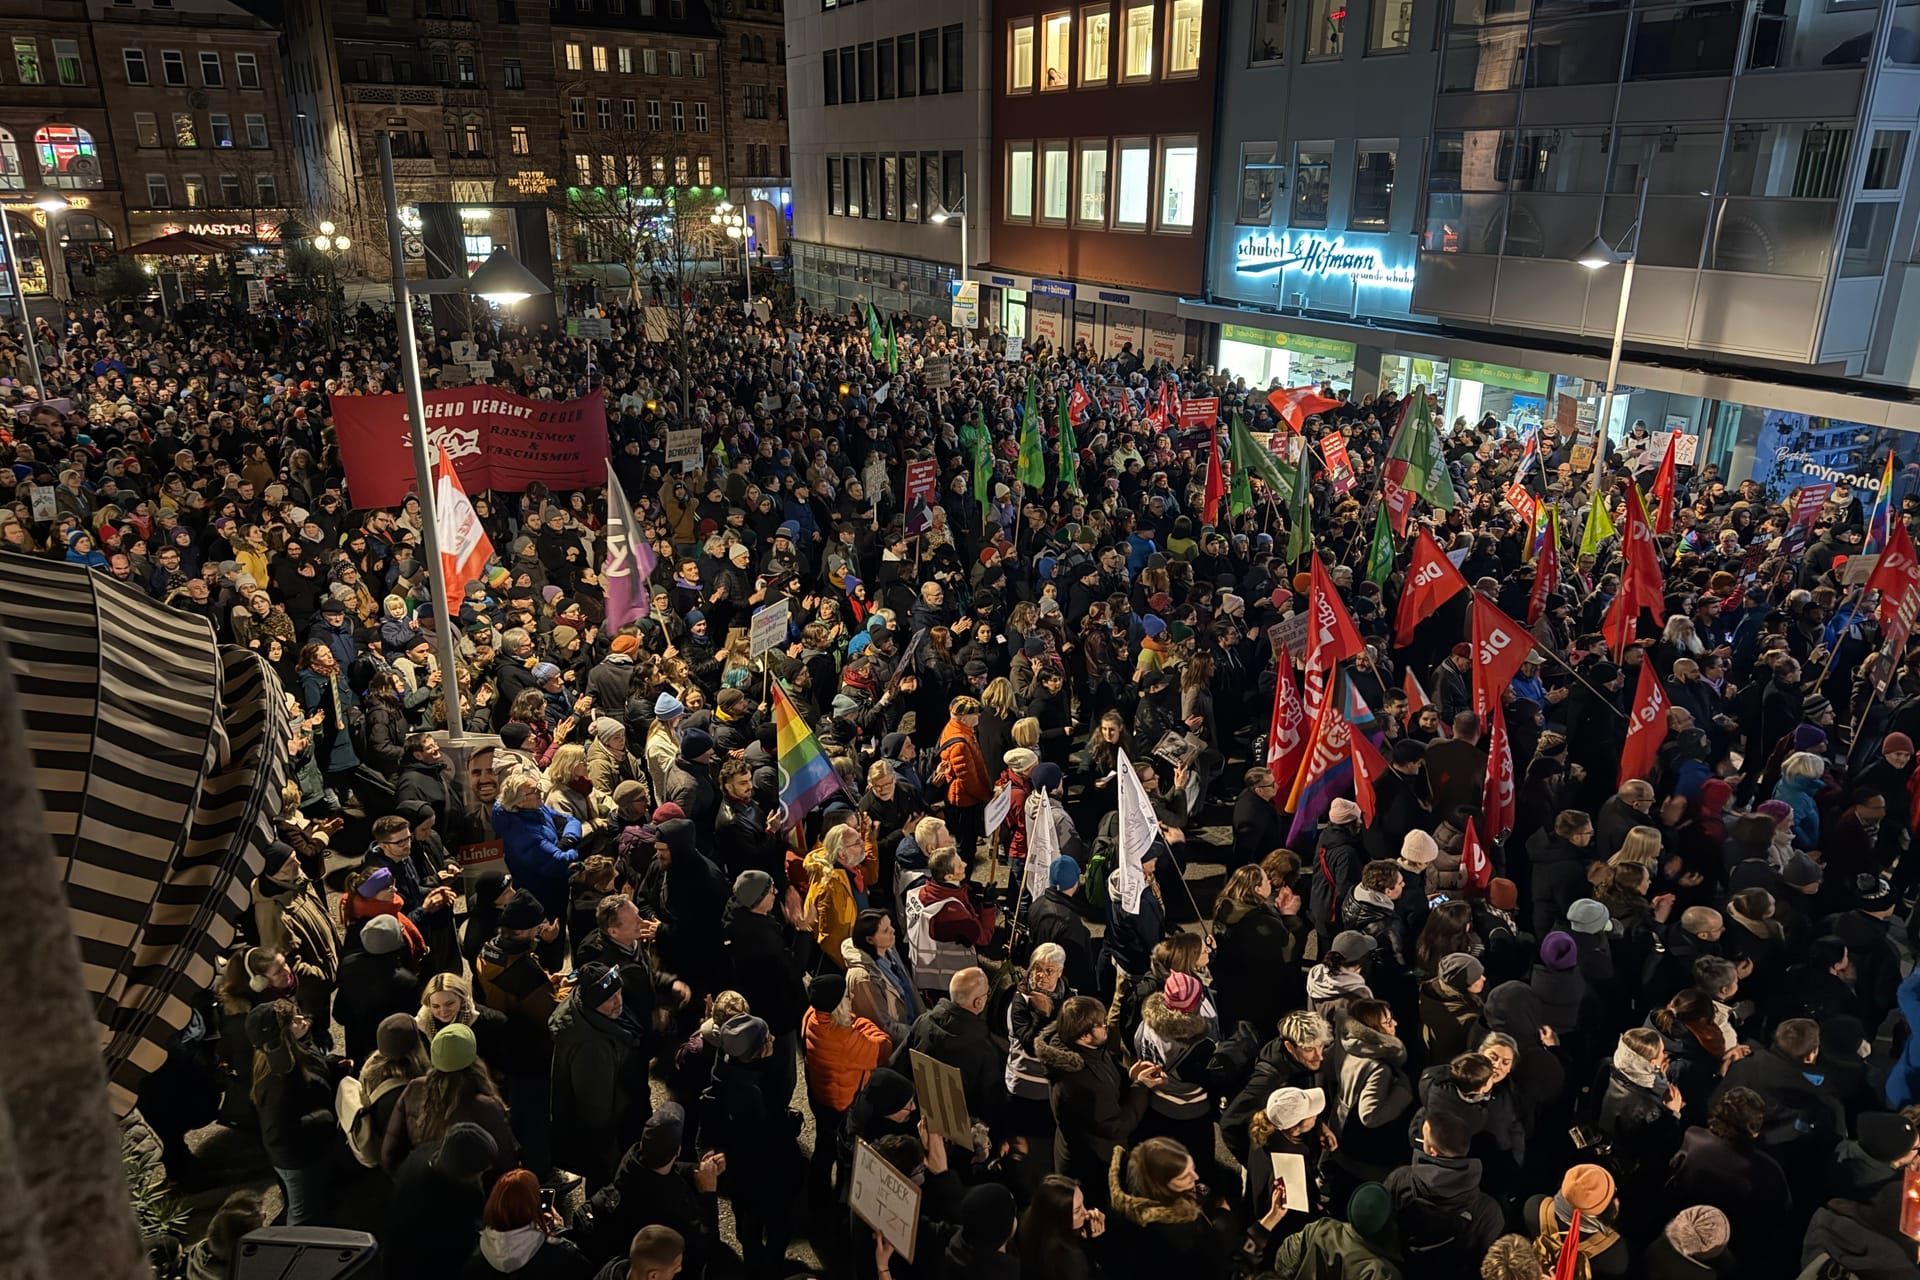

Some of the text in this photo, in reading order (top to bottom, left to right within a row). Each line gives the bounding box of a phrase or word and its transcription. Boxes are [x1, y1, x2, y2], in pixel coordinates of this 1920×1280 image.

[188, 223, 251, 235] MAESTRO
[1238, 236, 1284, 258] schübel
[1351, 270, 1383, 284] gesunde
[472, 399, 533, 420] VEREINT
[489, 425, 576, 443] RASSISMUS
[528, 441, 540, 451] &
[1802, 463, 1880, 491] mymoria
[463, 847, 498, 861] Linke
